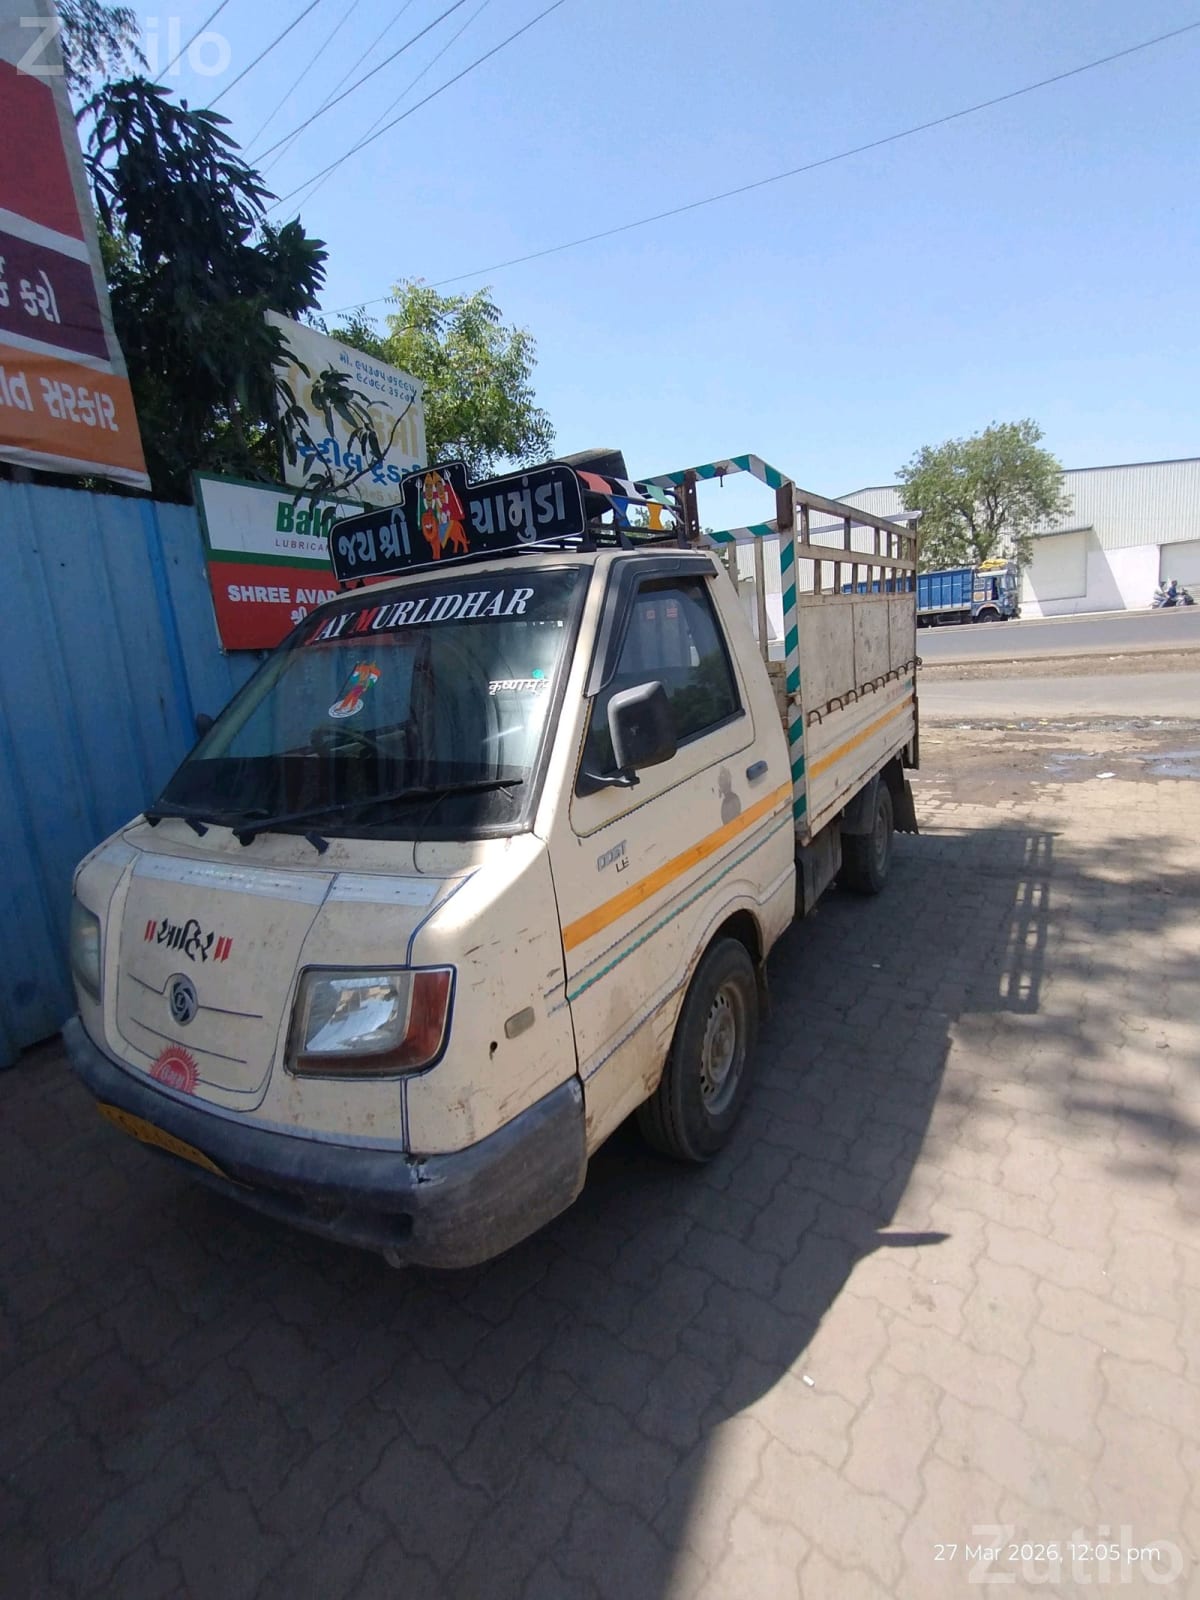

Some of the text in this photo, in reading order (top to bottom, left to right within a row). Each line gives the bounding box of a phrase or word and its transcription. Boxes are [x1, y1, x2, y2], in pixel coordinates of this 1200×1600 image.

[19, 269, 61, 324] કરો
[39, 376, 119, 432] સરકાર
[275, 539, 332, 552] LUBRICA
[338, 476, 566, 566] જય શ્રી ચામુંડા
[228, 584, 291, 604] SHREE
[304, 588, 534, 646] JAY MURLIDHAR
[615, 856, 630, 874] LE
